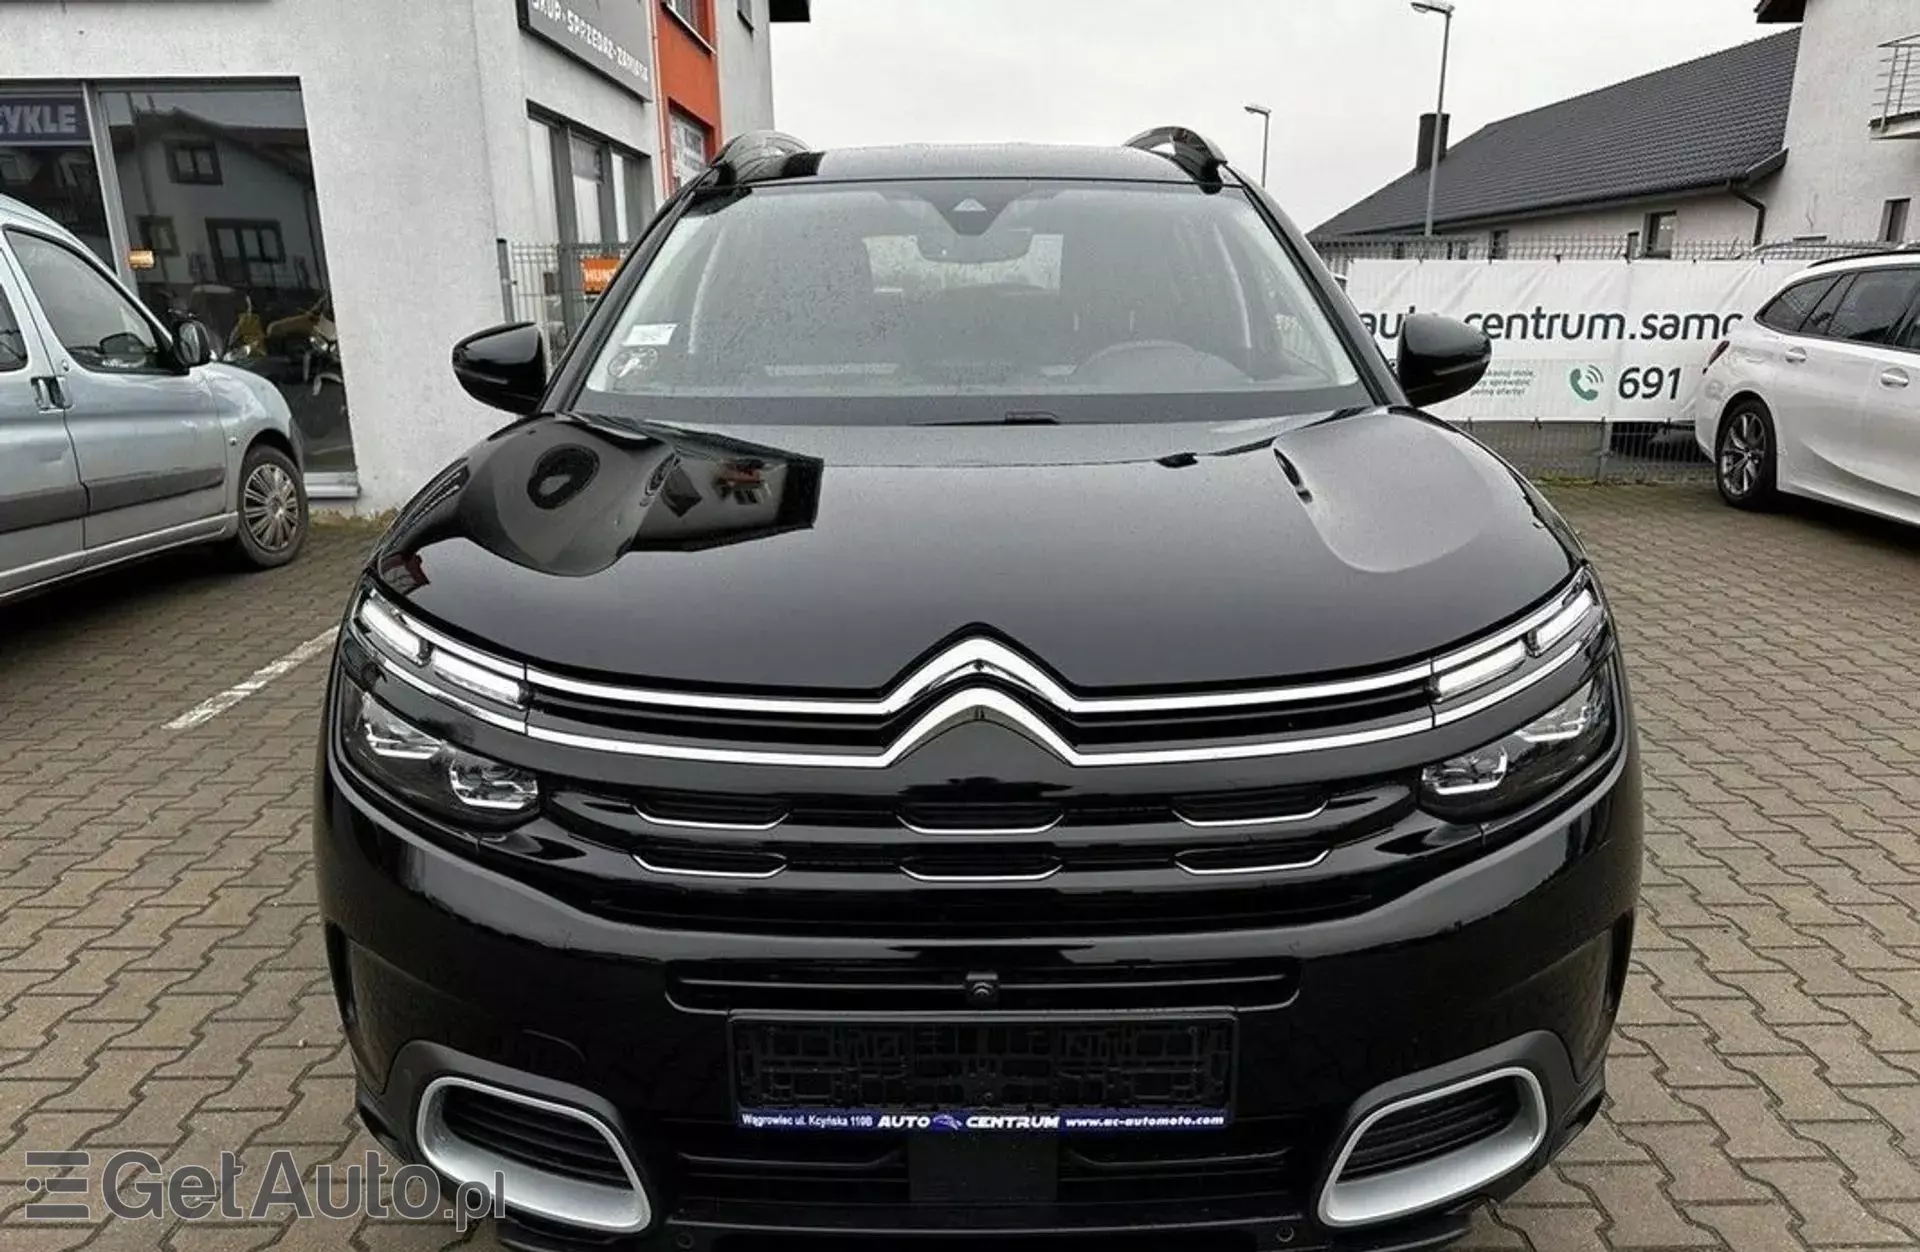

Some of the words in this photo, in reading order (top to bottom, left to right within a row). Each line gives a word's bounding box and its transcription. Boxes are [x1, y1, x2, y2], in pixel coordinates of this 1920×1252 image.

[0, 104, 77, 134] YKLE
[1618, 367, 1682, 400] 691
[877, 1115, 931, 1128] AUTO
[966, 1115, 1061, 1129] CENTRUM
